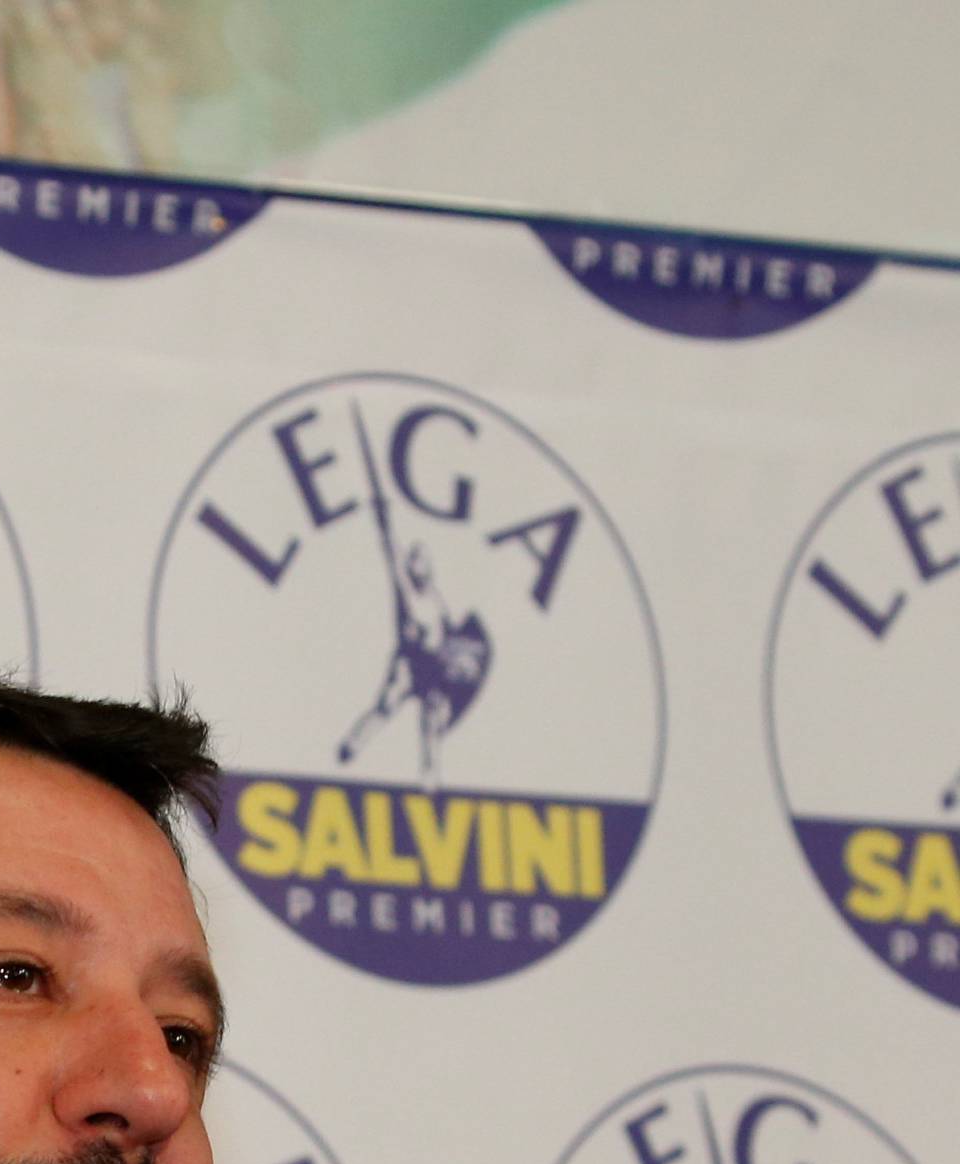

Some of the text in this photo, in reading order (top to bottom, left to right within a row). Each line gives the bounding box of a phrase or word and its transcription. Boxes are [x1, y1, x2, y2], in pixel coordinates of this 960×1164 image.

[572, 237, 837, 299] PREMIER
[196, 403, 582, 611] LEGA
[236, 780, 606, 897] SALVINI
[286, 887, 563, 941] PREMIER
